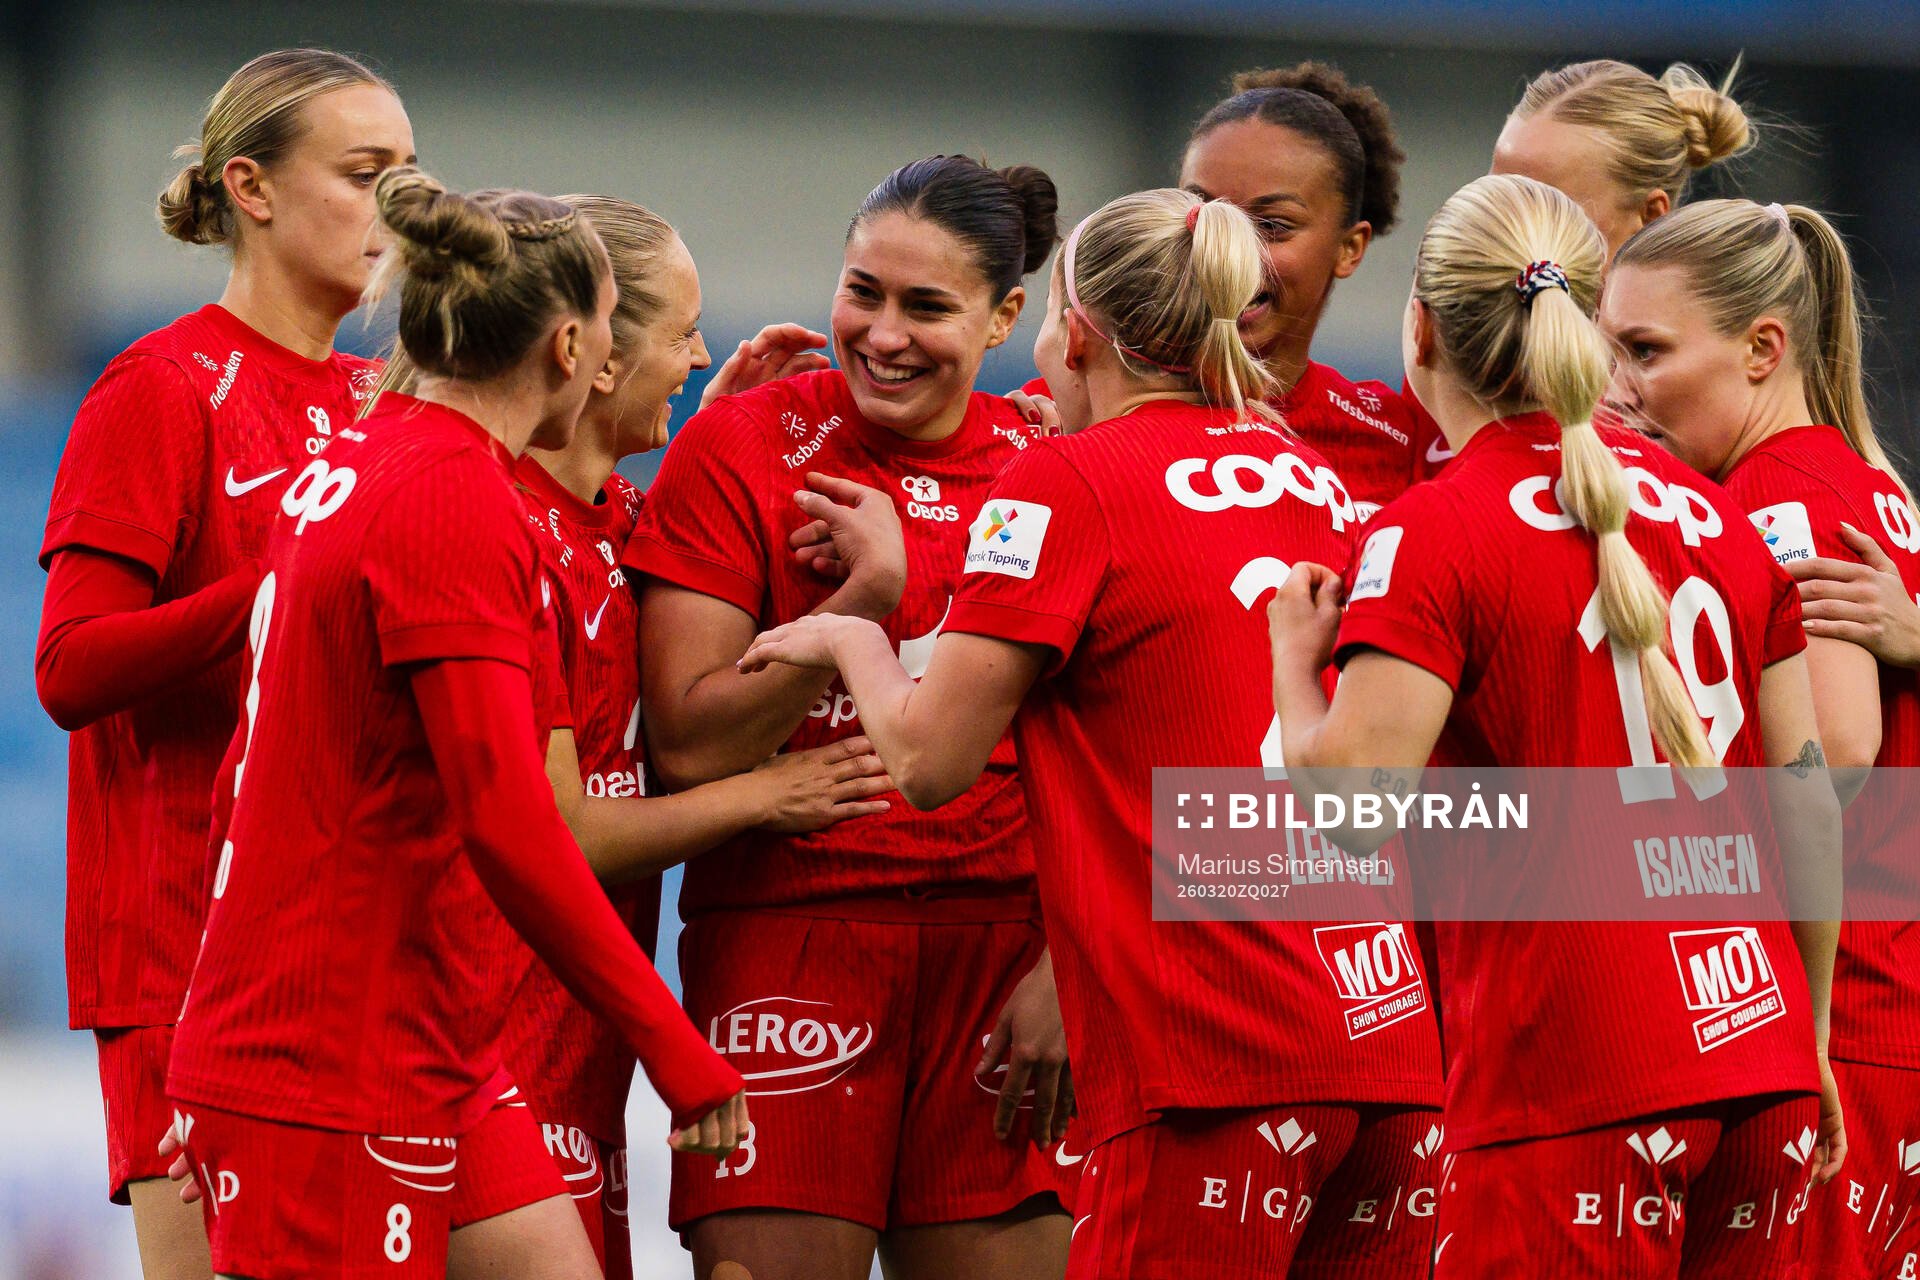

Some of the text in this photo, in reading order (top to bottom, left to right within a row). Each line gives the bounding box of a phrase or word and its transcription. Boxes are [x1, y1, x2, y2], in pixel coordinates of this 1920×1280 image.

[1327, 389, 1409, 446] Tidsbanken
[907, 501, 959, 522] OBOS
[1165, 452, 1355, 532] coop
[988, 550, 1030, 571] Tipping
[1577, 575, 1744, 804] 19
[1633, 834, 1760, 898] ISAKSEN
[1334, 924, 1414, 998] MOT
[1688, 928, 1770, 1007] MOT
[709, 1013, 861, 1058] LERØY
[1352, 990, 1422, 1030] SHOW COURAGE!
[1702, 996, 1778, 1042] SHOW COURAGE!
[383, 1203, 412, 1263] 8
